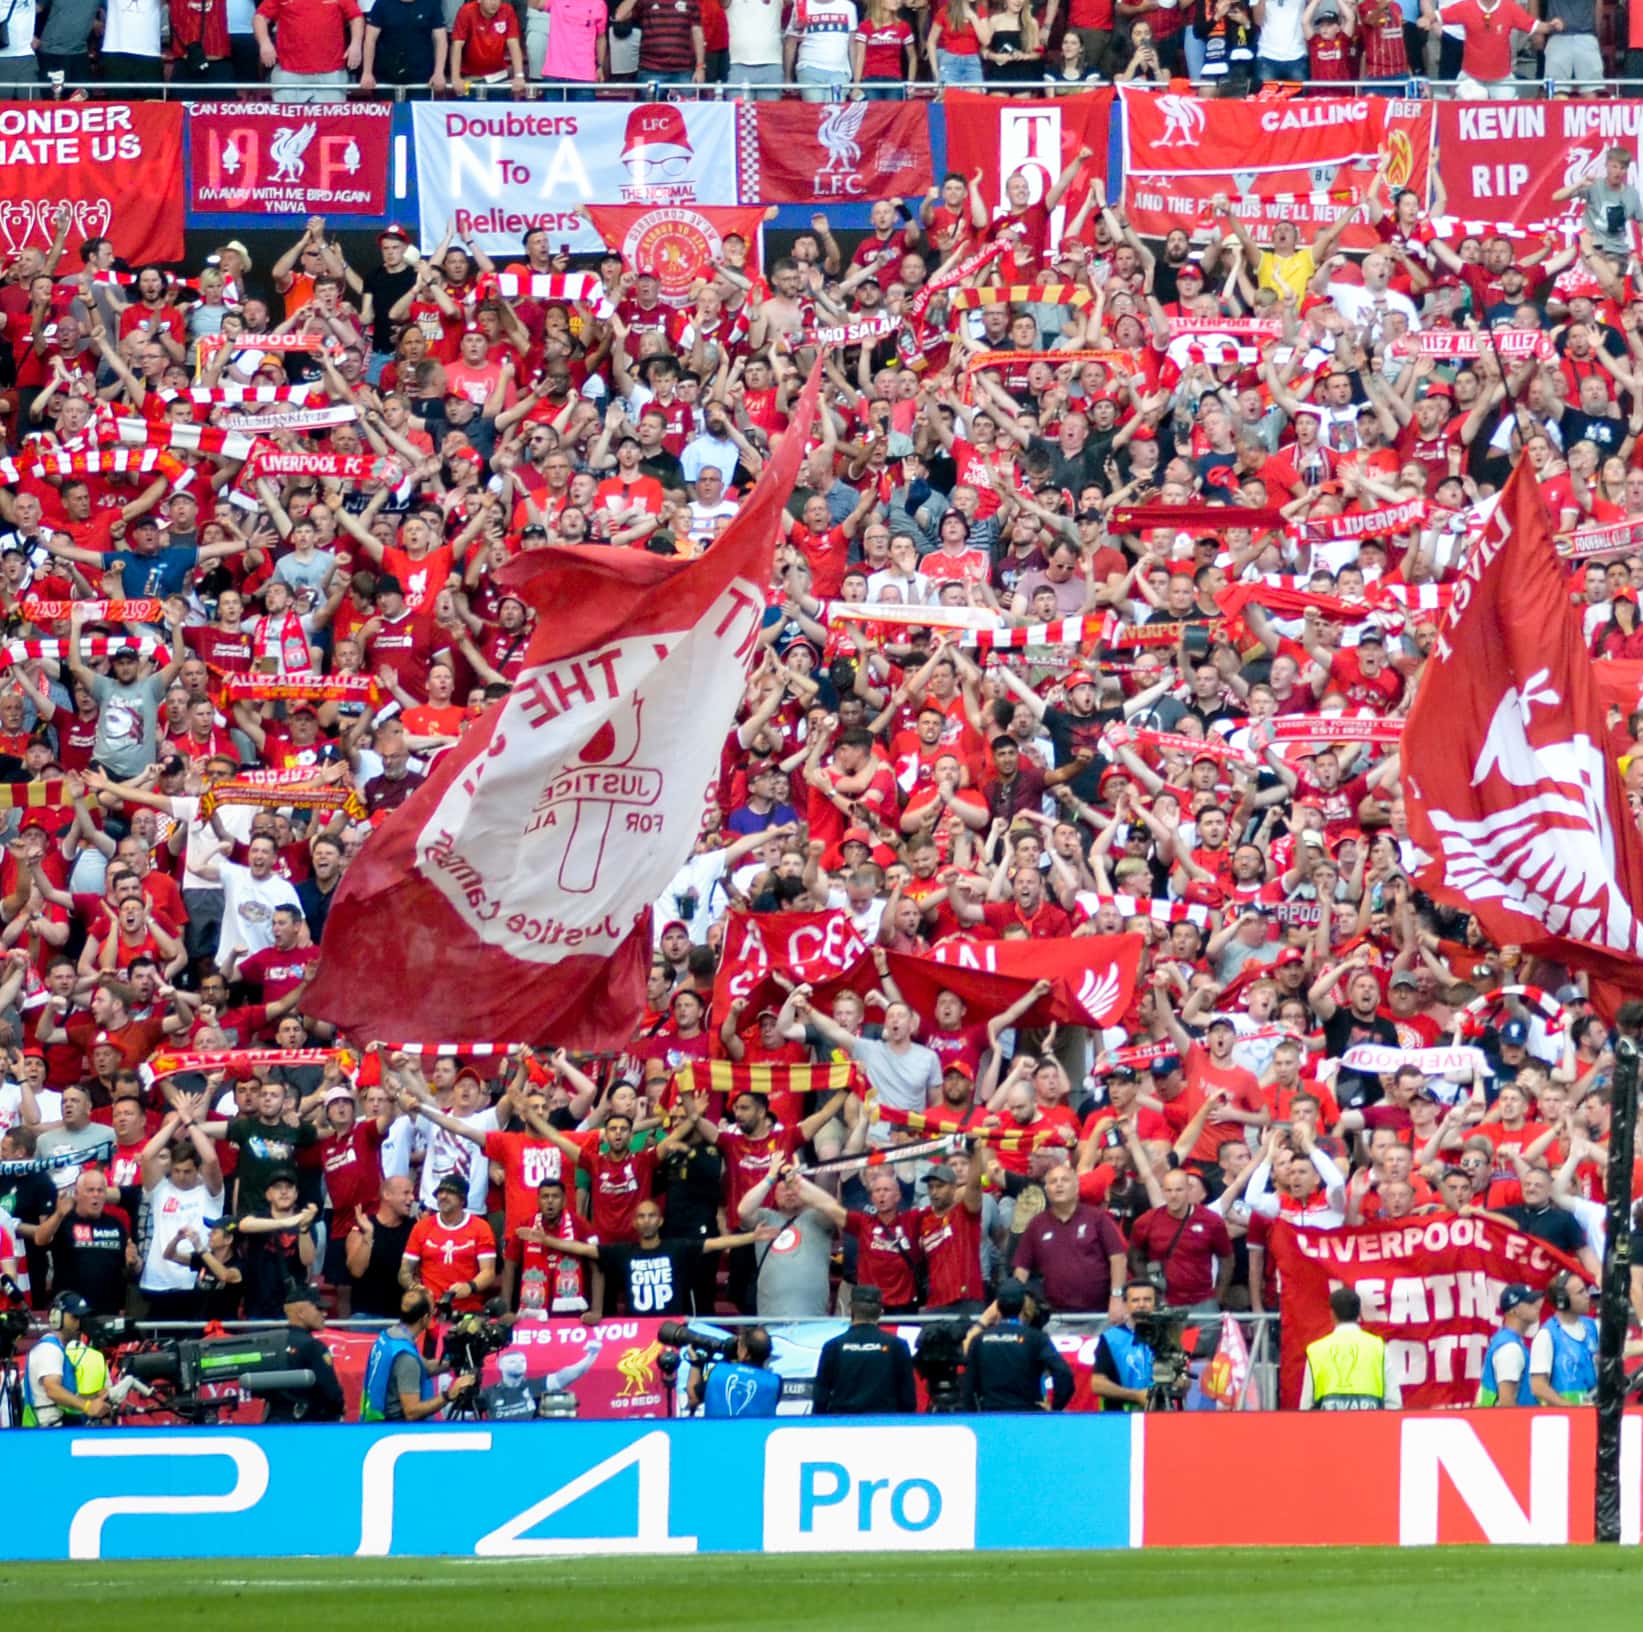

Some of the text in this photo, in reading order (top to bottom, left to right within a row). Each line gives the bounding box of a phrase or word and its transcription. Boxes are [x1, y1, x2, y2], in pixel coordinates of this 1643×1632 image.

[445, 113, 578, 138] Doubters
[641, 118, 671, 132] LFC
[1260, 102, 1368, 131] CALLING
[496, 159, 531, 186] To
[1472, 163, 1528, 199] RIP
[265, 200, 307, 214] YNWA
[1134, 192, 1195, 213] AND THE
[455, 206, 580, 235] Believers
[1500, 332, 1540, 352] ALLEZ
[261, 454, 364, 474] LIVERPOOL FC
[1333, 501, 1425, 538] LIVERPOOL
[1297, 1216, 1558, 1271] LIVERPOOL F.C.
[630, 1257, 670, 1270] NEVER
[630, 1269, 673, 1285] GIVE
[632, 1285, 674, 1312] UP
[559, 1322, 638, 1344] TO YOU
[69, 1429, 699, 1561] PS4
[799, 1459, 944, 1534] Pro
